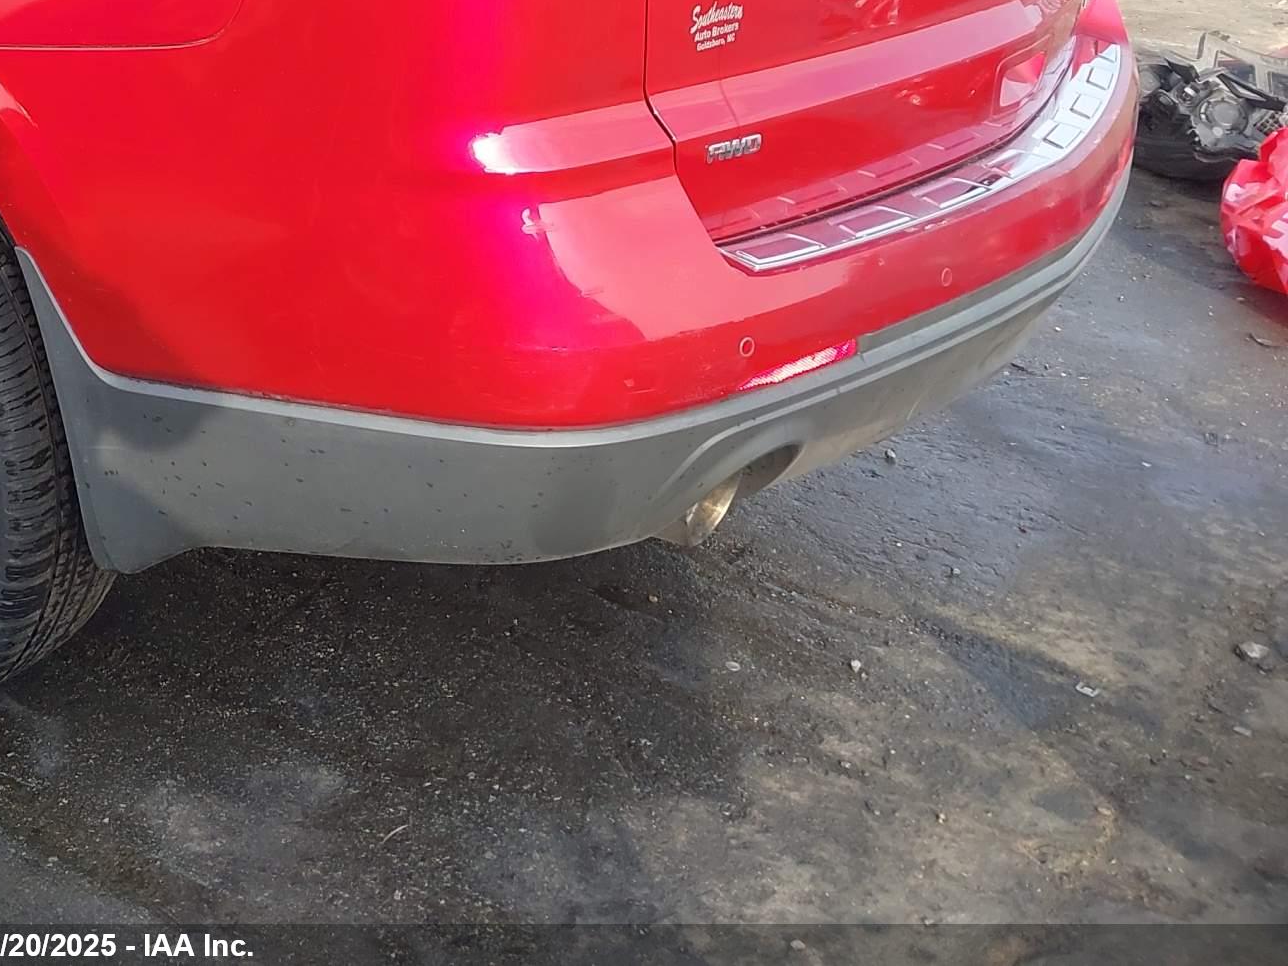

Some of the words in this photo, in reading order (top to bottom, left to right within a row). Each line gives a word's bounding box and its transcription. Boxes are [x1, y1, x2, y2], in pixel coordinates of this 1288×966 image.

[690, 1, 743, 34] Southeastern
[694, 29, 711, 43] Auto
[712, 22, 739, 37] Brokers
[726, 32, 736, 43] NC
